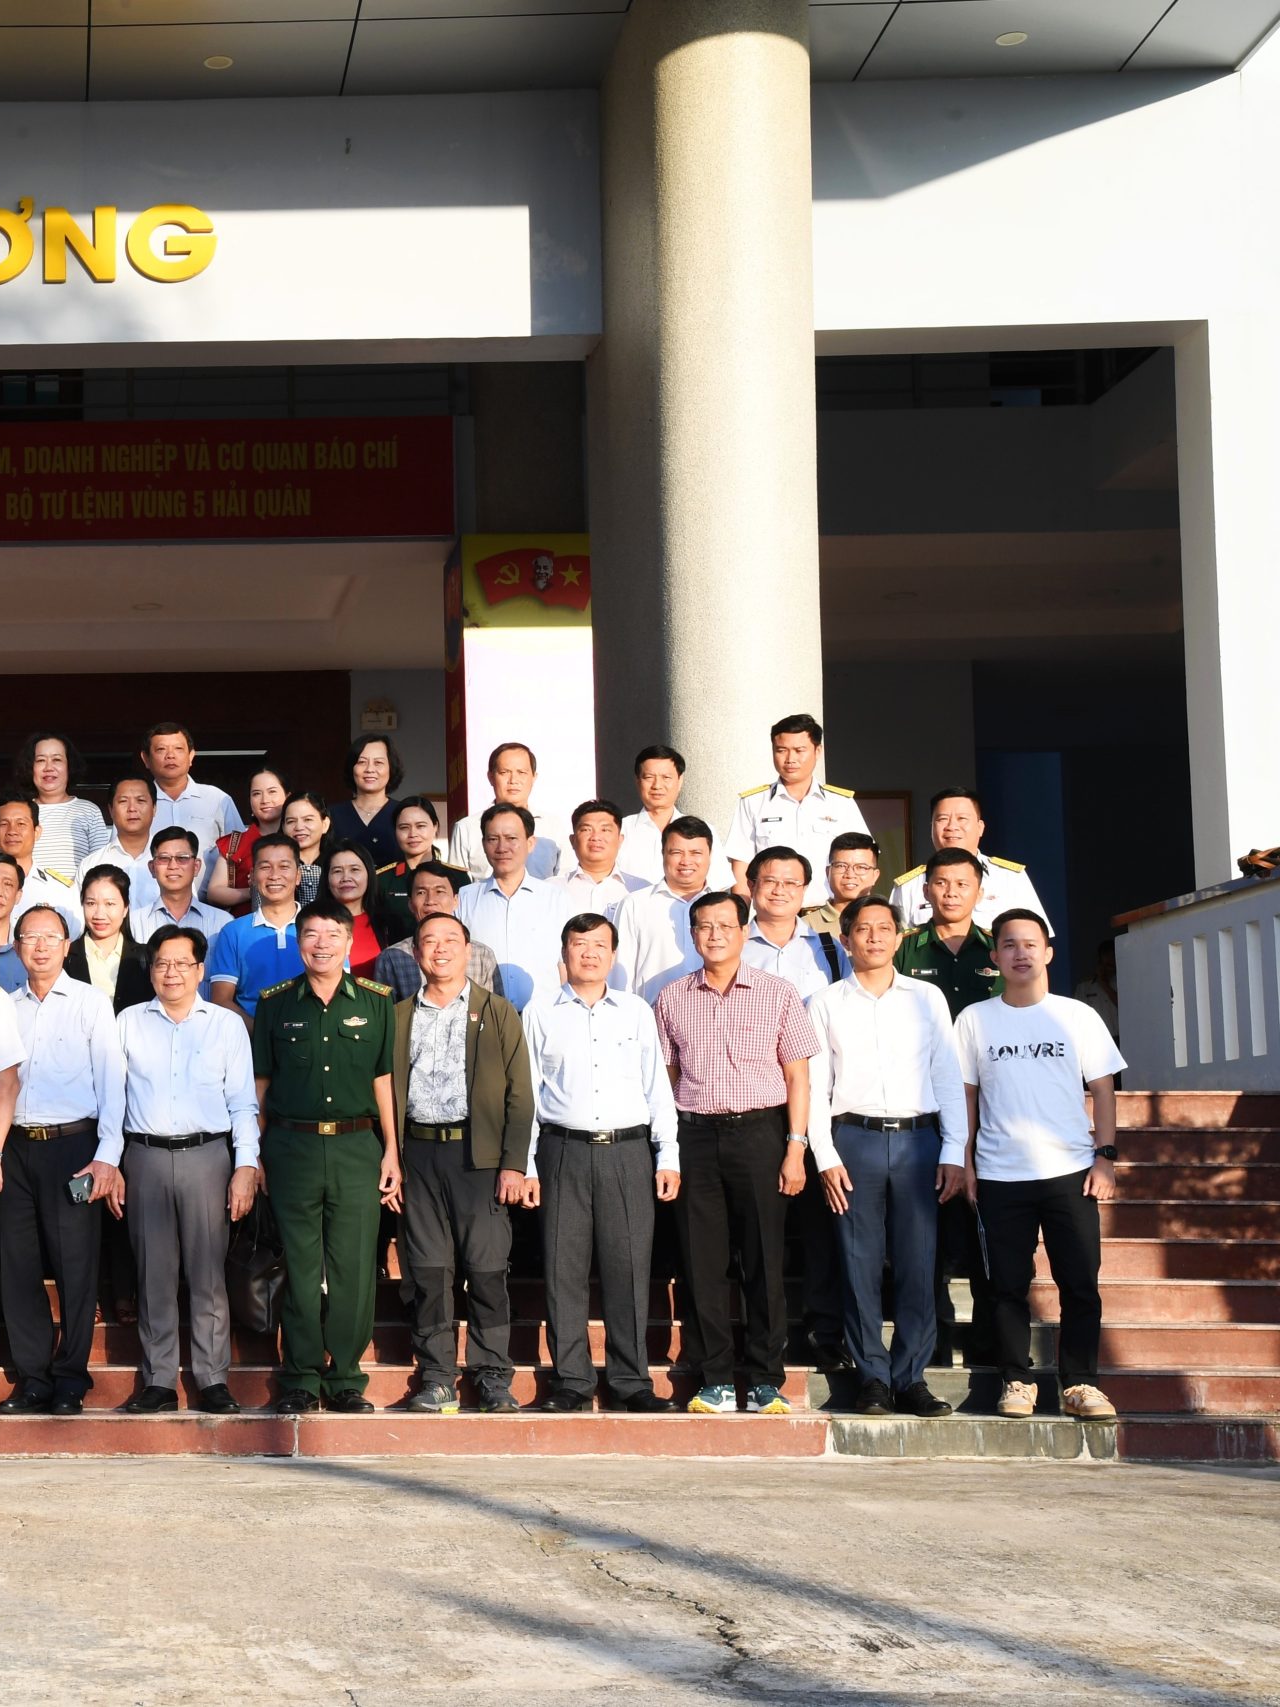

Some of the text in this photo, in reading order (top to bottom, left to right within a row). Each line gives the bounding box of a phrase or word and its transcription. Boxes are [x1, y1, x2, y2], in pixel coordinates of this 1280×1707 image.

[24, 446, 94, 474] DOANH
[102, 439, 177, 477] NGHIỆP
[185, 438, 210, 471] VÀ
[218, 440, 244, 471] CƠ
[253, 443, 307, 473] QUAN
[315, 436, 355, 469] BÁO
[364, 435, 397, 469] CHÍ
[6, 487, 32, 526] BỘ
[40, 490, 64, 520] TƯ
[72, 486, 124, 525] LỆNH
[131, 485, 186, 518] VÙNG
[194, 490, 205, 518] 5
[213, 480, 246, 517] HẢI
[254, 483, 310, 520] QUÂN
[987, 1041, 1065, 1061] LOUVRE
